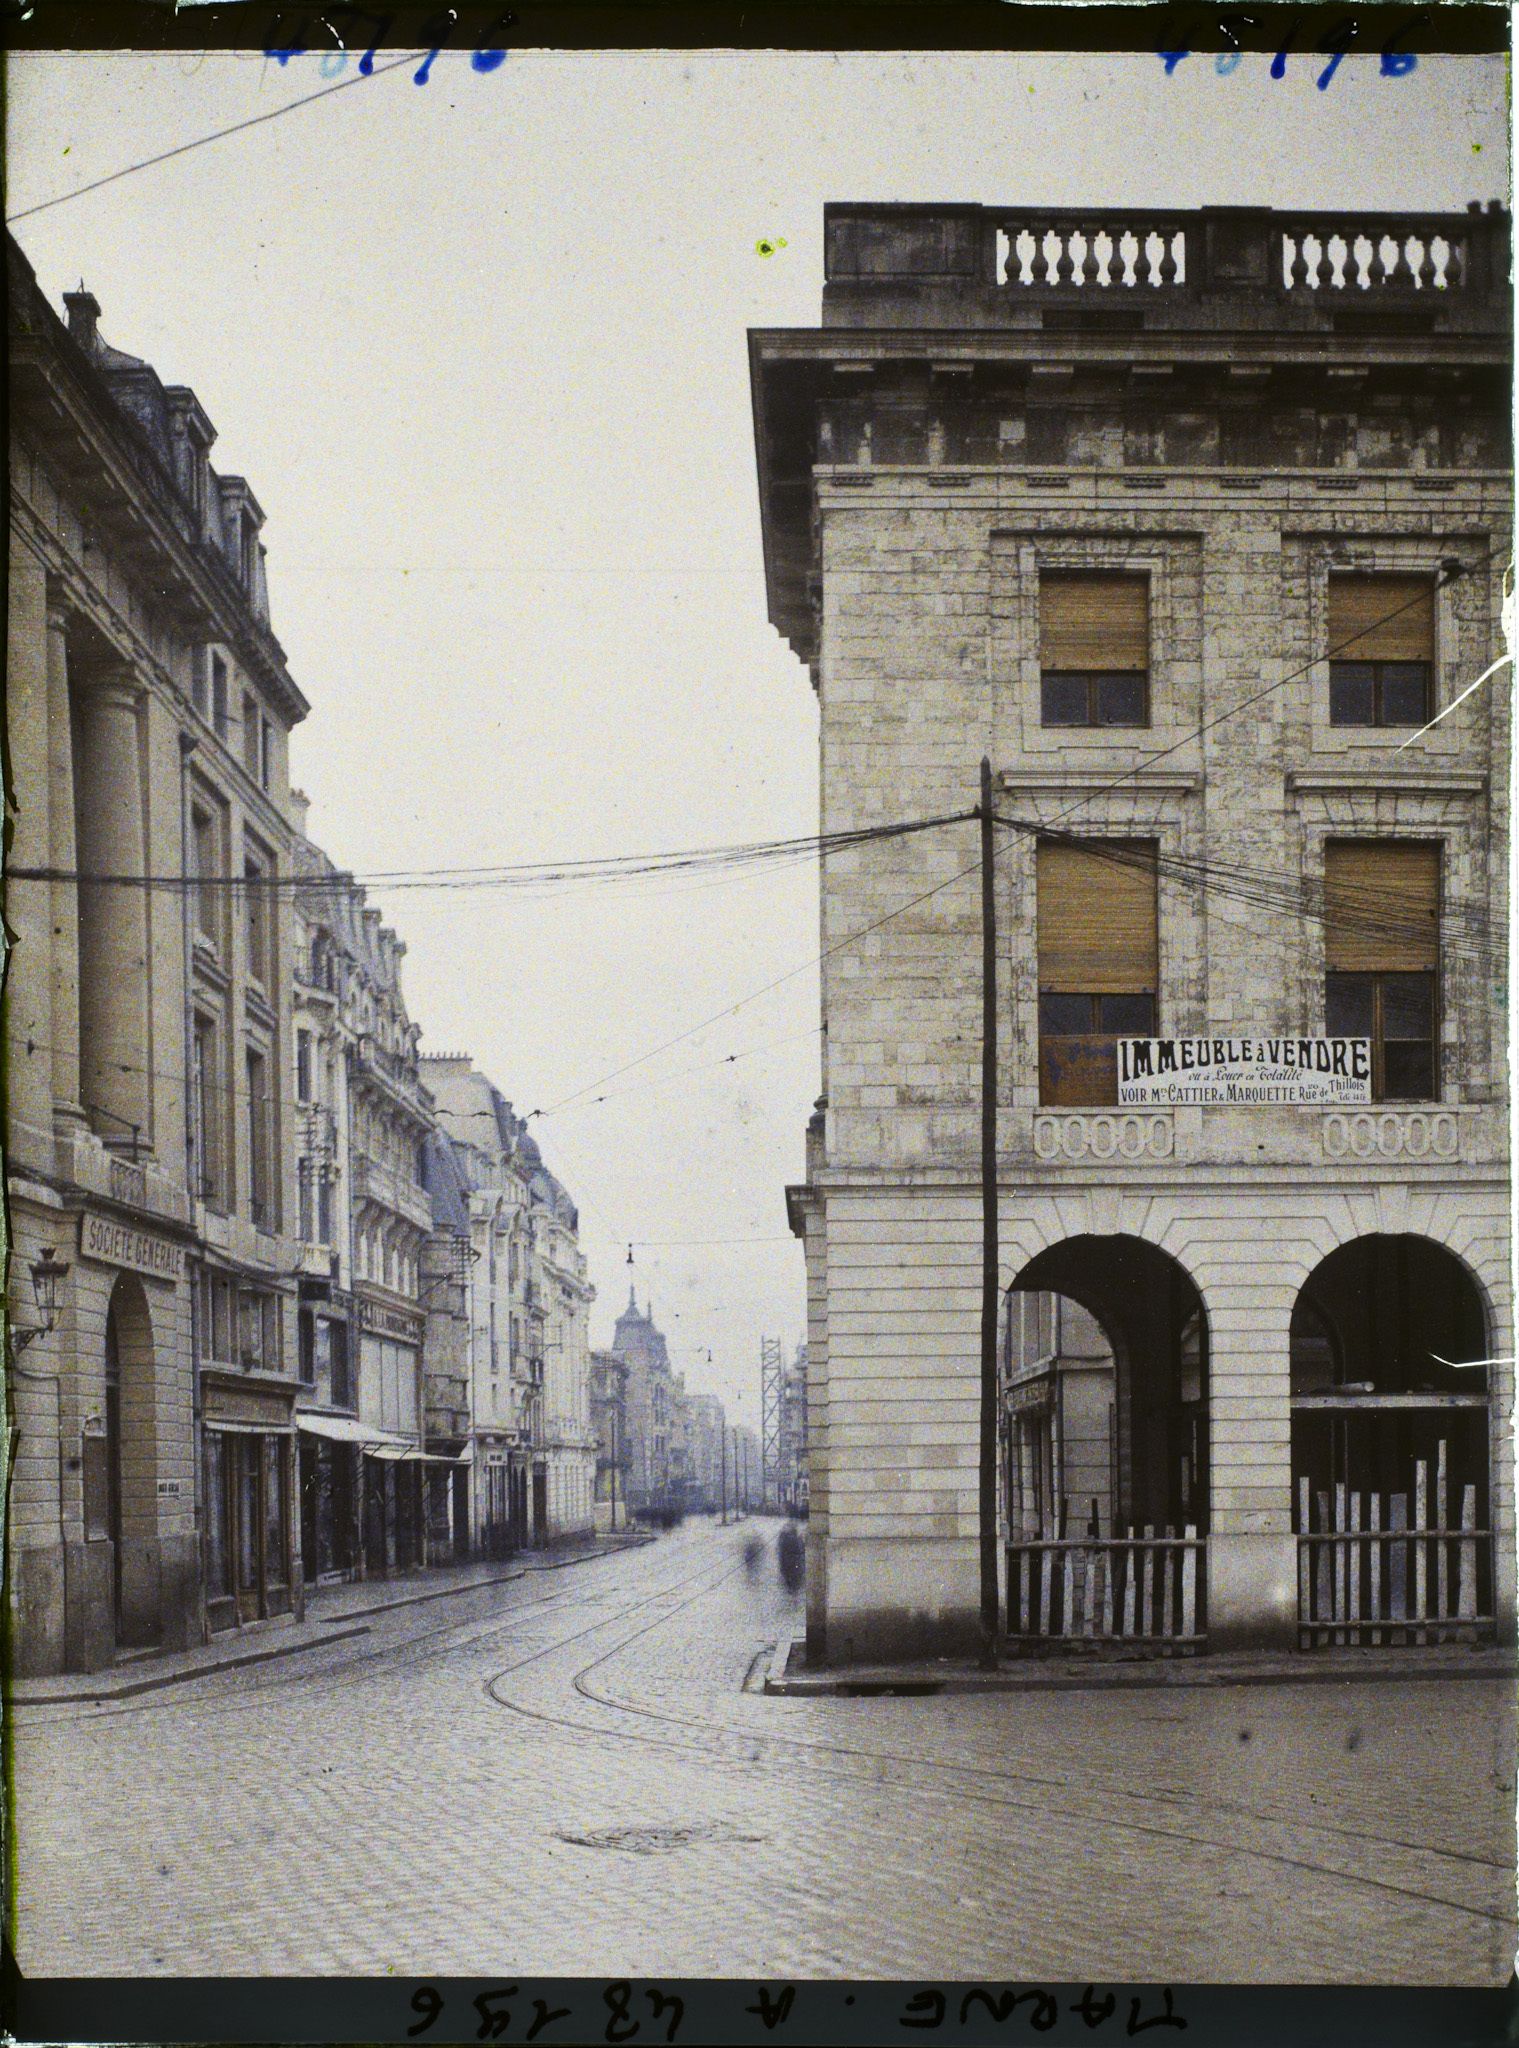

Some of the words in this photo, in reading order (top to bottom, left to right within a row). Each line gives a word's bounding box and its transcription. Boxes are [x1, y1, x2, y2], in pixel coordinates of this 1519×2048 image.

[1120, 1040, 1252, 1082] IMMEUBLE
[1257, 1043, 1265, 1063] à
[1267, 1039, 1370, 1080] VENDRE
[1212, 1066, 1244, 1081] Louer
[1121, 1087, 1147, 1102] VOIR
[1168, 1083, 1218, 1102] CATTIER
[1226, 1083, 1297, 1103] MARQUETTE
[1299, 1086, 1317, 1102] Rue
[1328, 1077, 1365, 1093] Thillois
[900, 1986, 1188, 2039] MARNE
